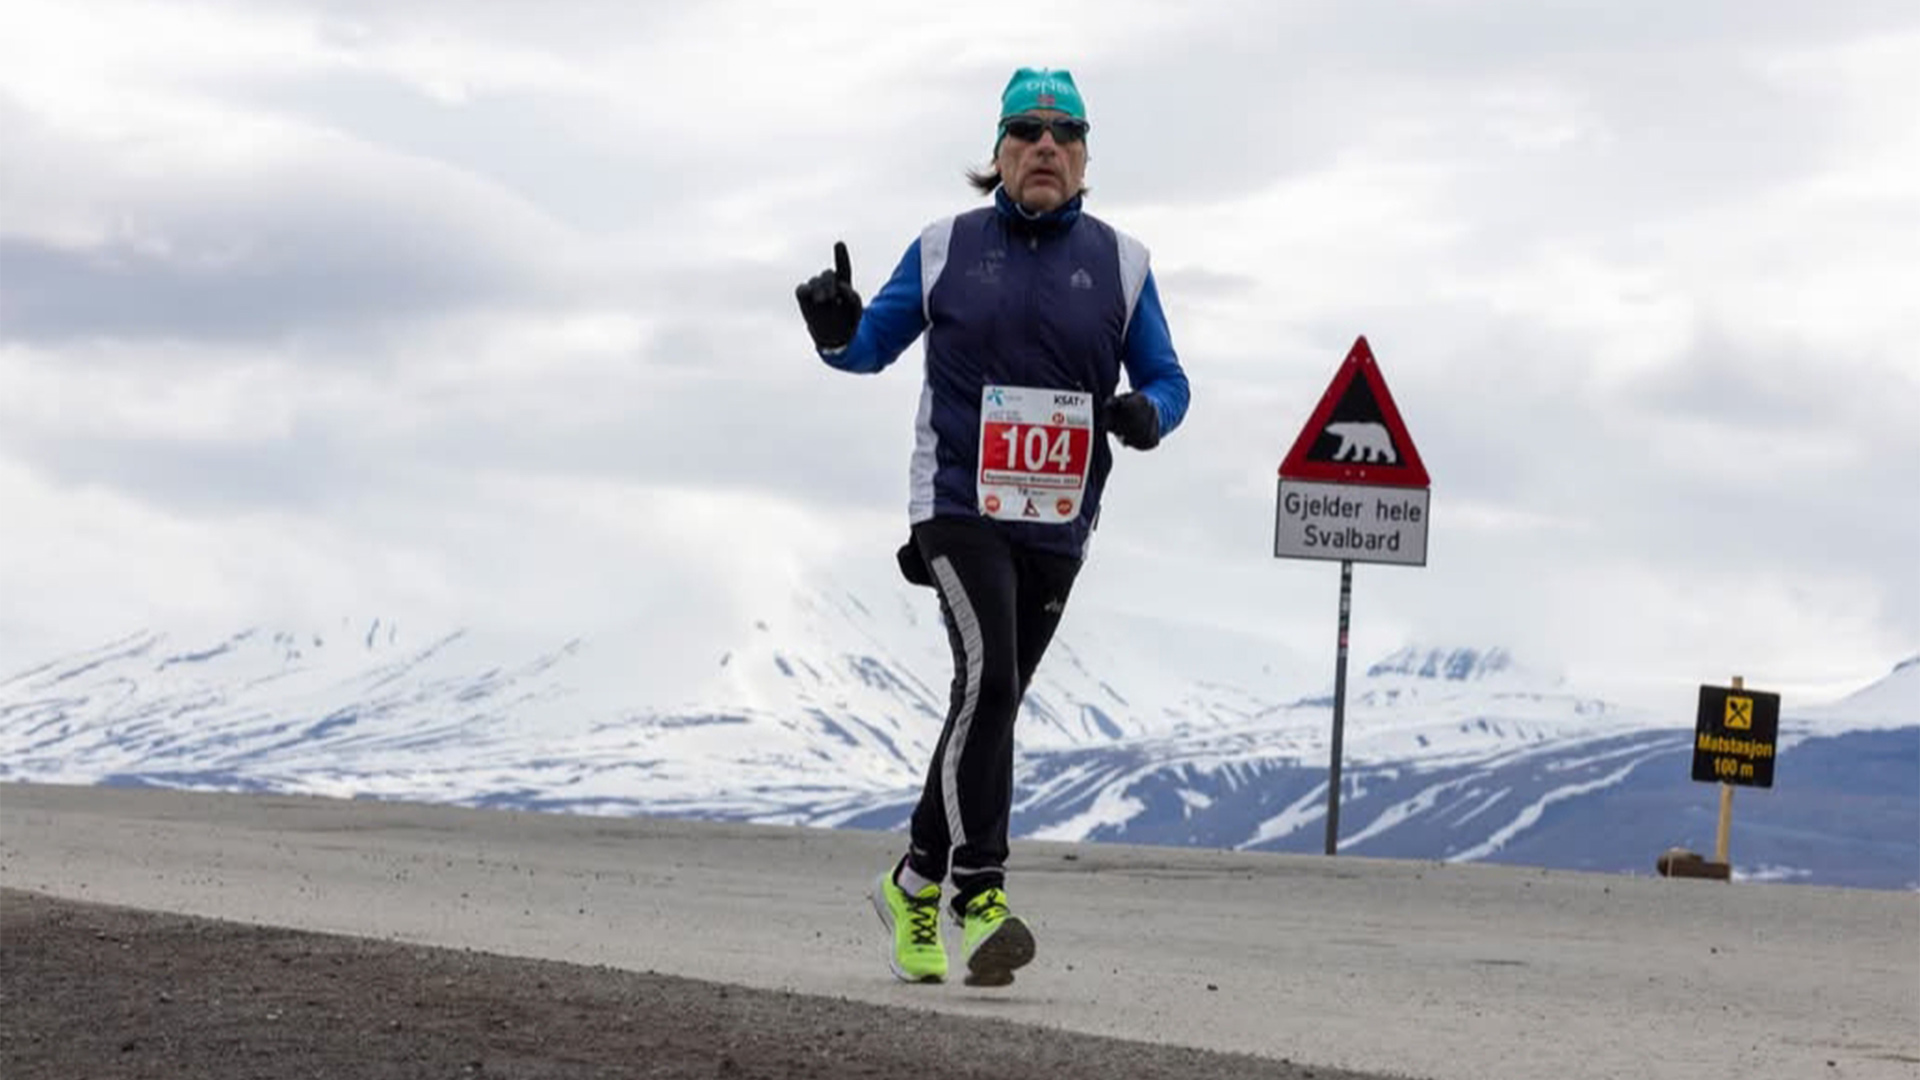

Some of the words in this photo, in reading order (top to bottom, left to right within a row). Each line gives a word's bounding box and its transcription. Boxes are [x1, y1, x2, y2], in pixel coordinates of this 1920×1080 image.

[1054, 394, 1079, 406] KSAT
[1002, 425, 1071, 472] 104
[1284, 492, 1363, 520] Gjelder
[1376, 498, 1421, 523] hele
[1303, 523, 1401, 552] Svalbard
[1698, 733, 1773, 759] Matstasjon
[1714, 757, 1738, 775] 100
[1741, 763, 1754, 777] m
